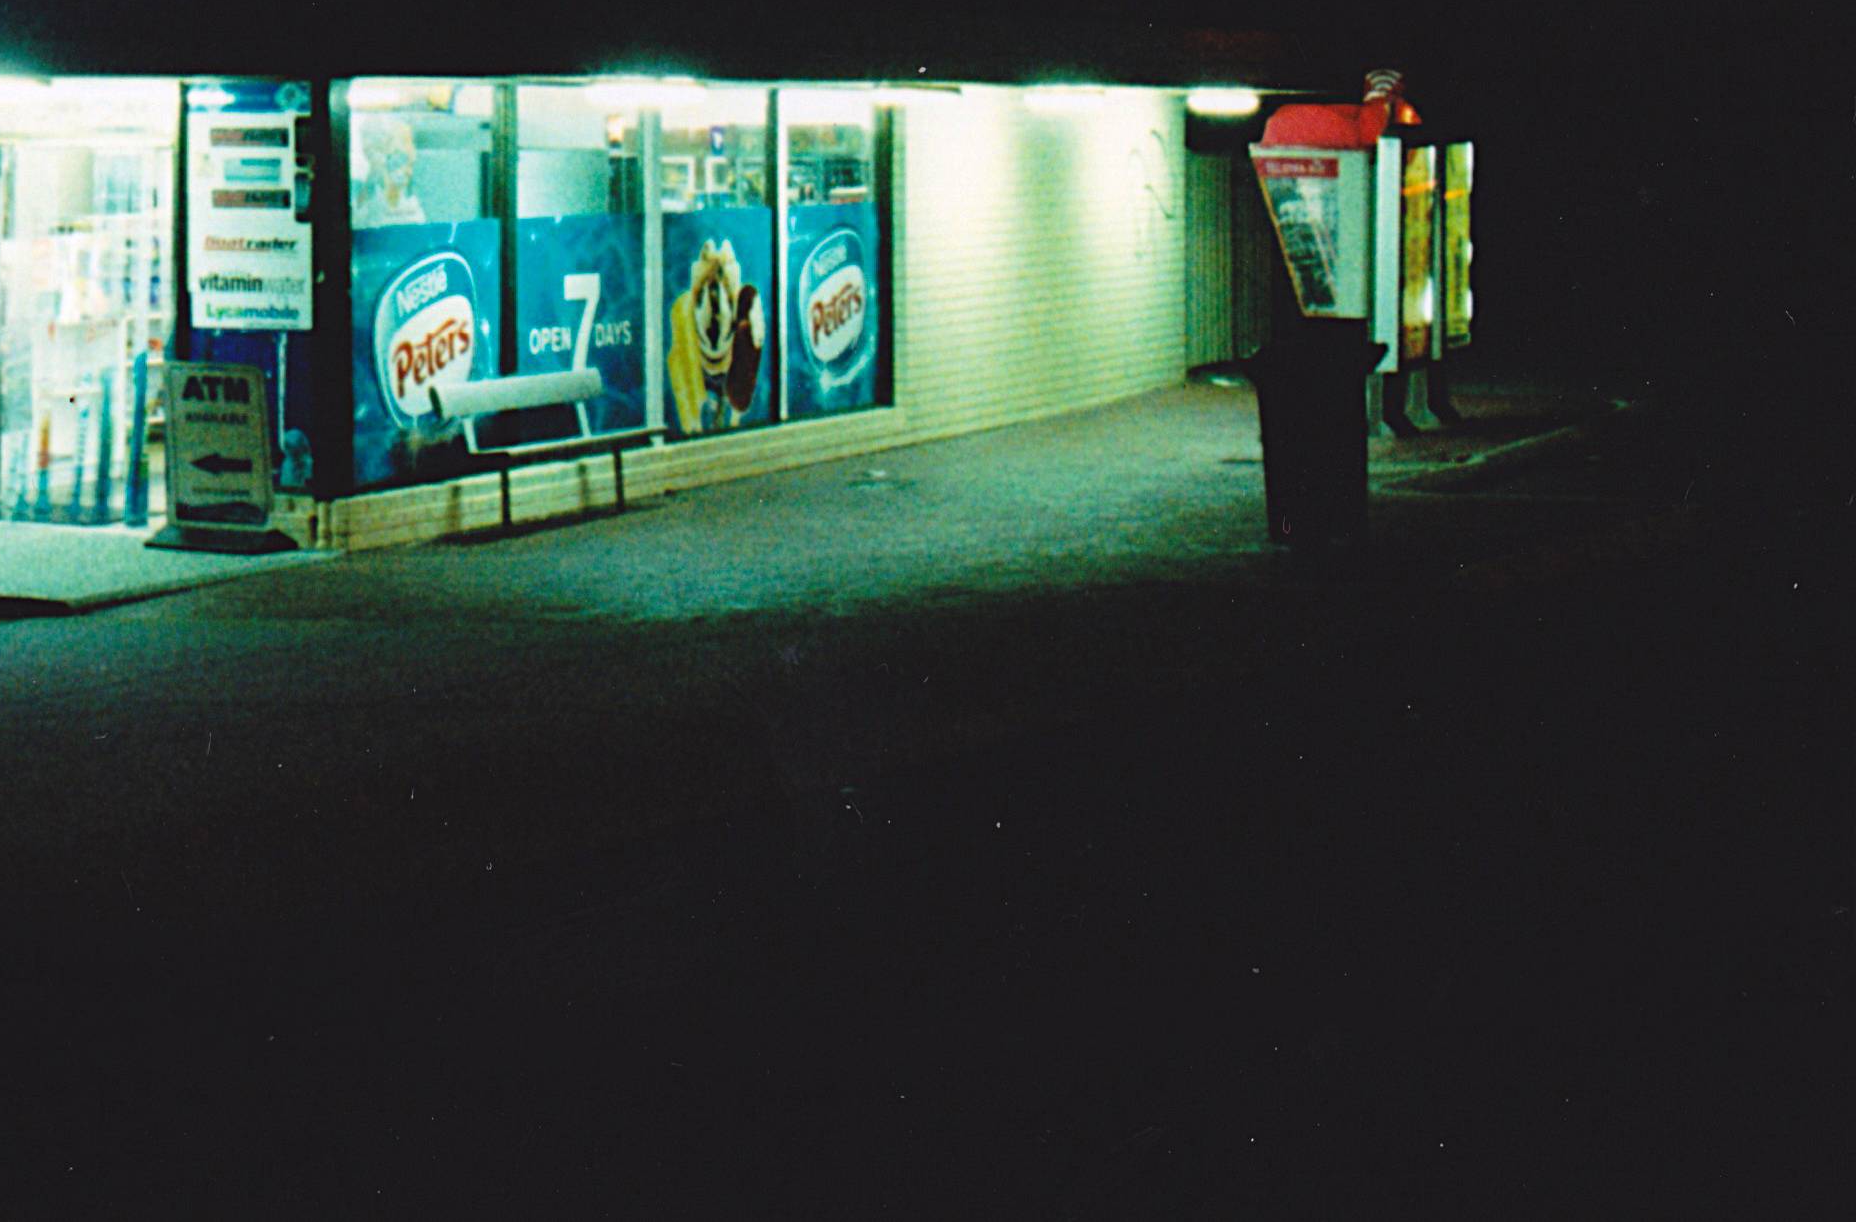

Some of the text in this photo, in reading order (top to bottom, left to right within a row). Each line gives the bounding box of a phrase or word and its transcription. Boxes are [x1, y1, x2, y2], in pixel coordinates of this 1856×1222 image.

[529, 273, 631, 371] OPEN 7 DAYS
[182, 375, 250, 404] ATM
